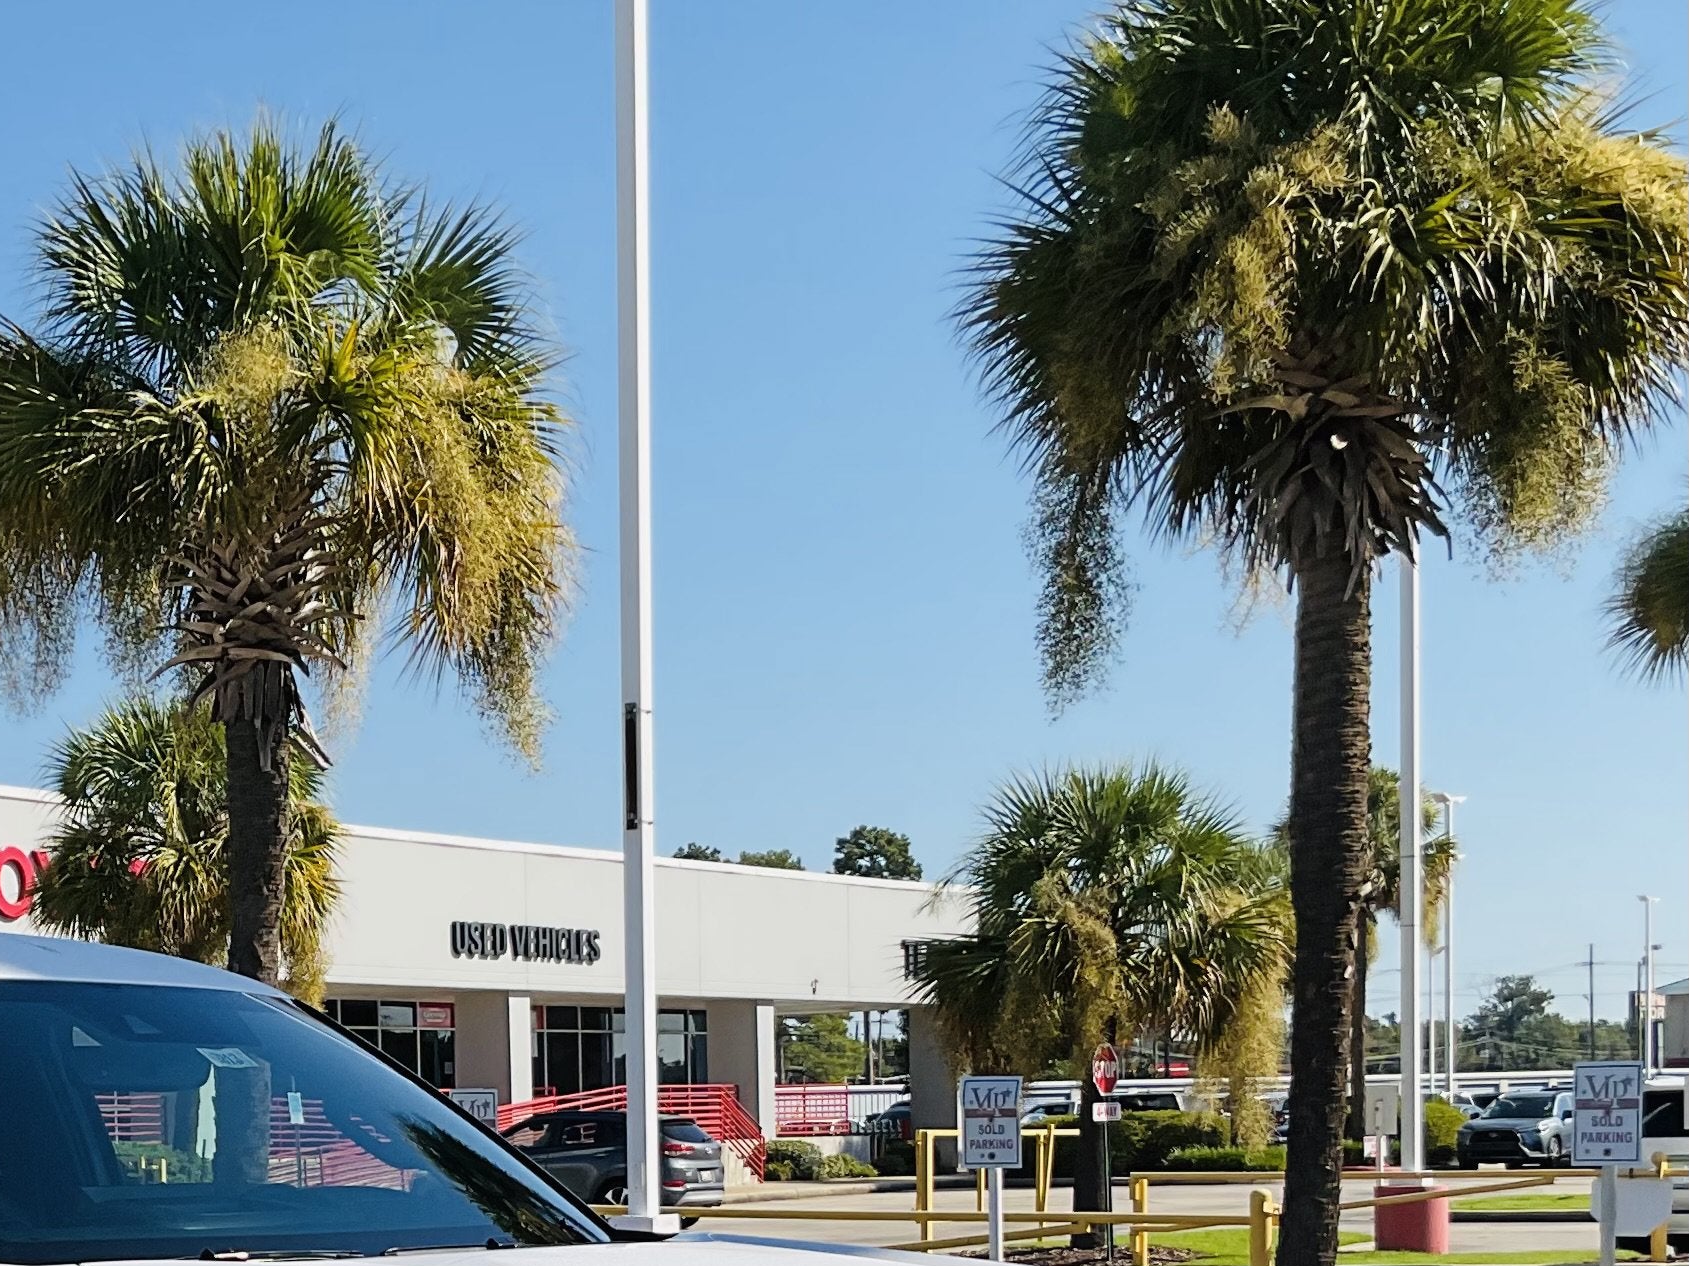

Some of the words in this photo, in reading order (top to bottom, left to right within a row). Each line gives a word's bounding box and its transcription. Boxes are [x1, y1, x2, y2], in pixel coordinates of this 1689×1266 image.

[450, 921, 507, 959] USED
[509, 925, 601, 966] VEHICLES
[1094, 1060, 1116, 1078] STOP
[1591, 1115, 1623, 1127] SOLD
[978, 1124, 1005, 1135] SOLD
[1580, 1132, 1633, 1144] PARKING
[969, 1139, 1014, 1150] PARKING
